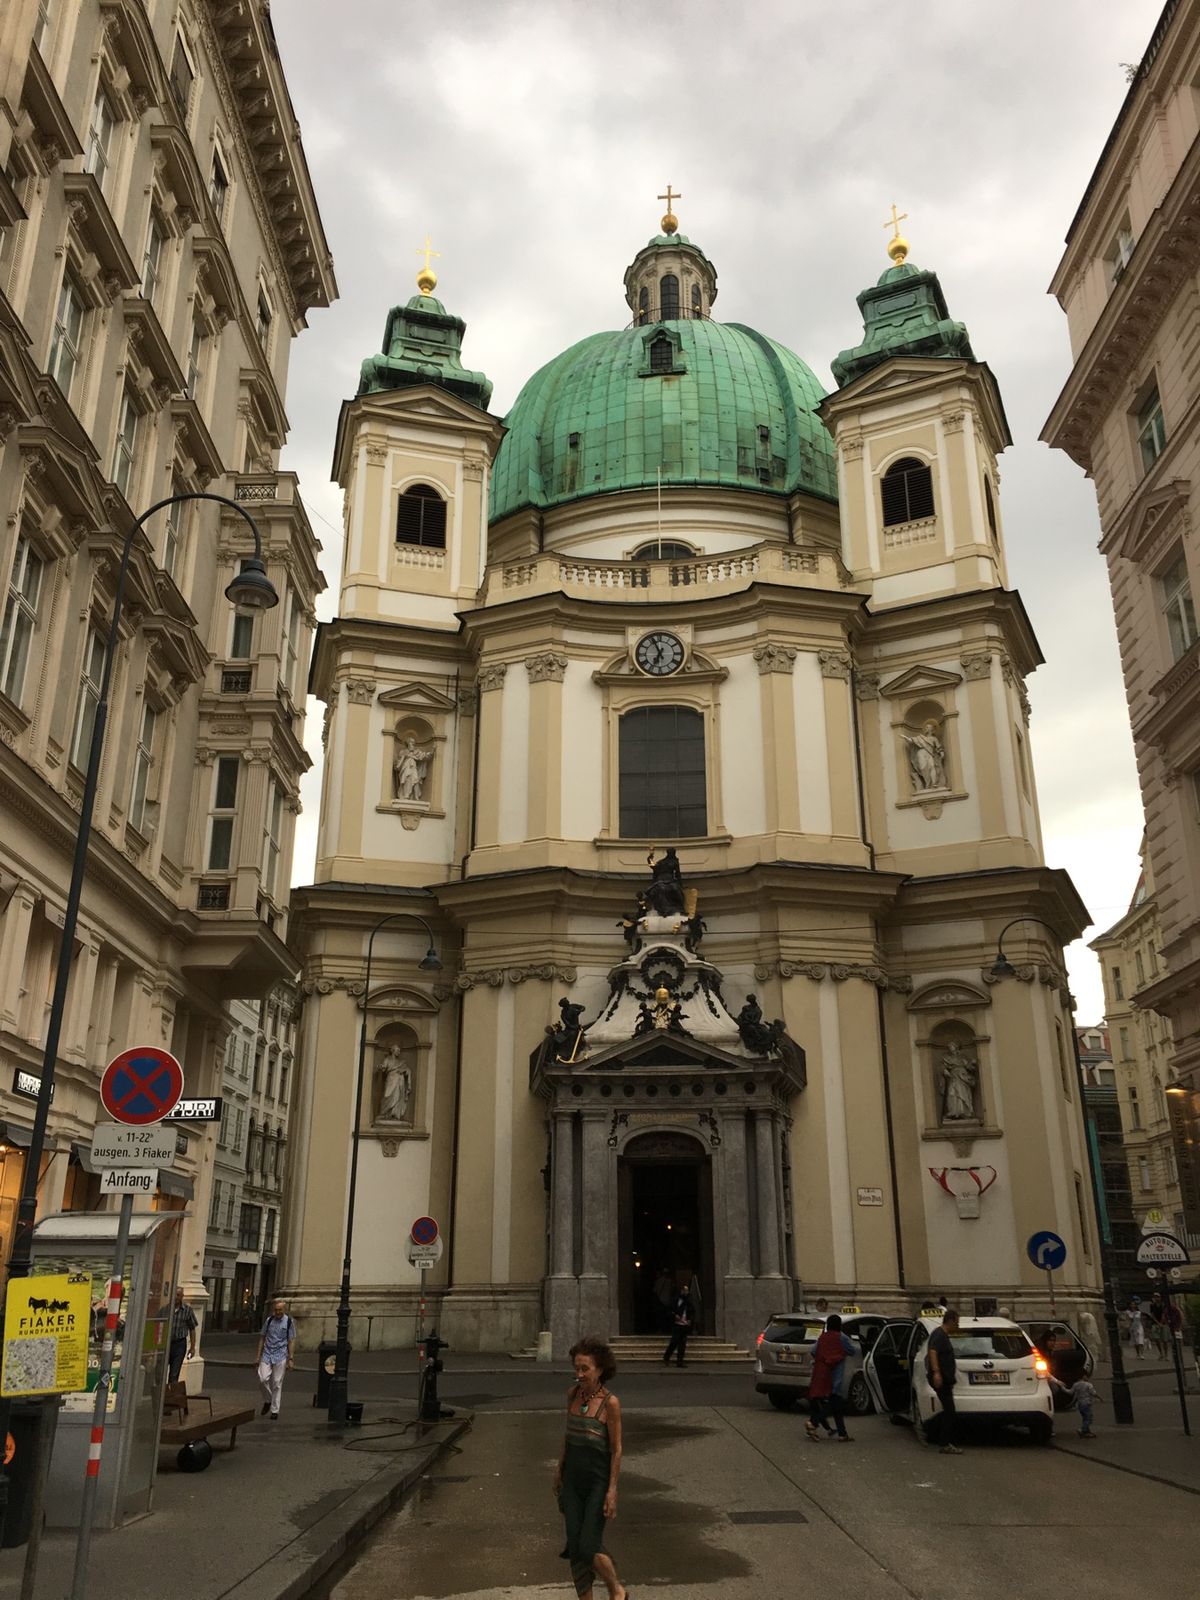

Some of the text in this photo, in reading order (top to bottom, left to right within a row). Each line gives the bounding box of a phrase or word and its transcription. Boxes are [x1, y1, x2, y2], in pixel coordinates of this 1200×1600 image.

[169, 1102, 213, 1117] PIJRI
[93, 1147, 172, 1159] ausgen. 3 Fiaker
[1144, 1237, 1176, 1249] AUTOBUS
[1141, 1253, 1182, 1261] HALTESTELLE
[19, 1314, 75, 1328] FIAKER
[18, 1326, 75, 1336] RUNDFAHRTEN
